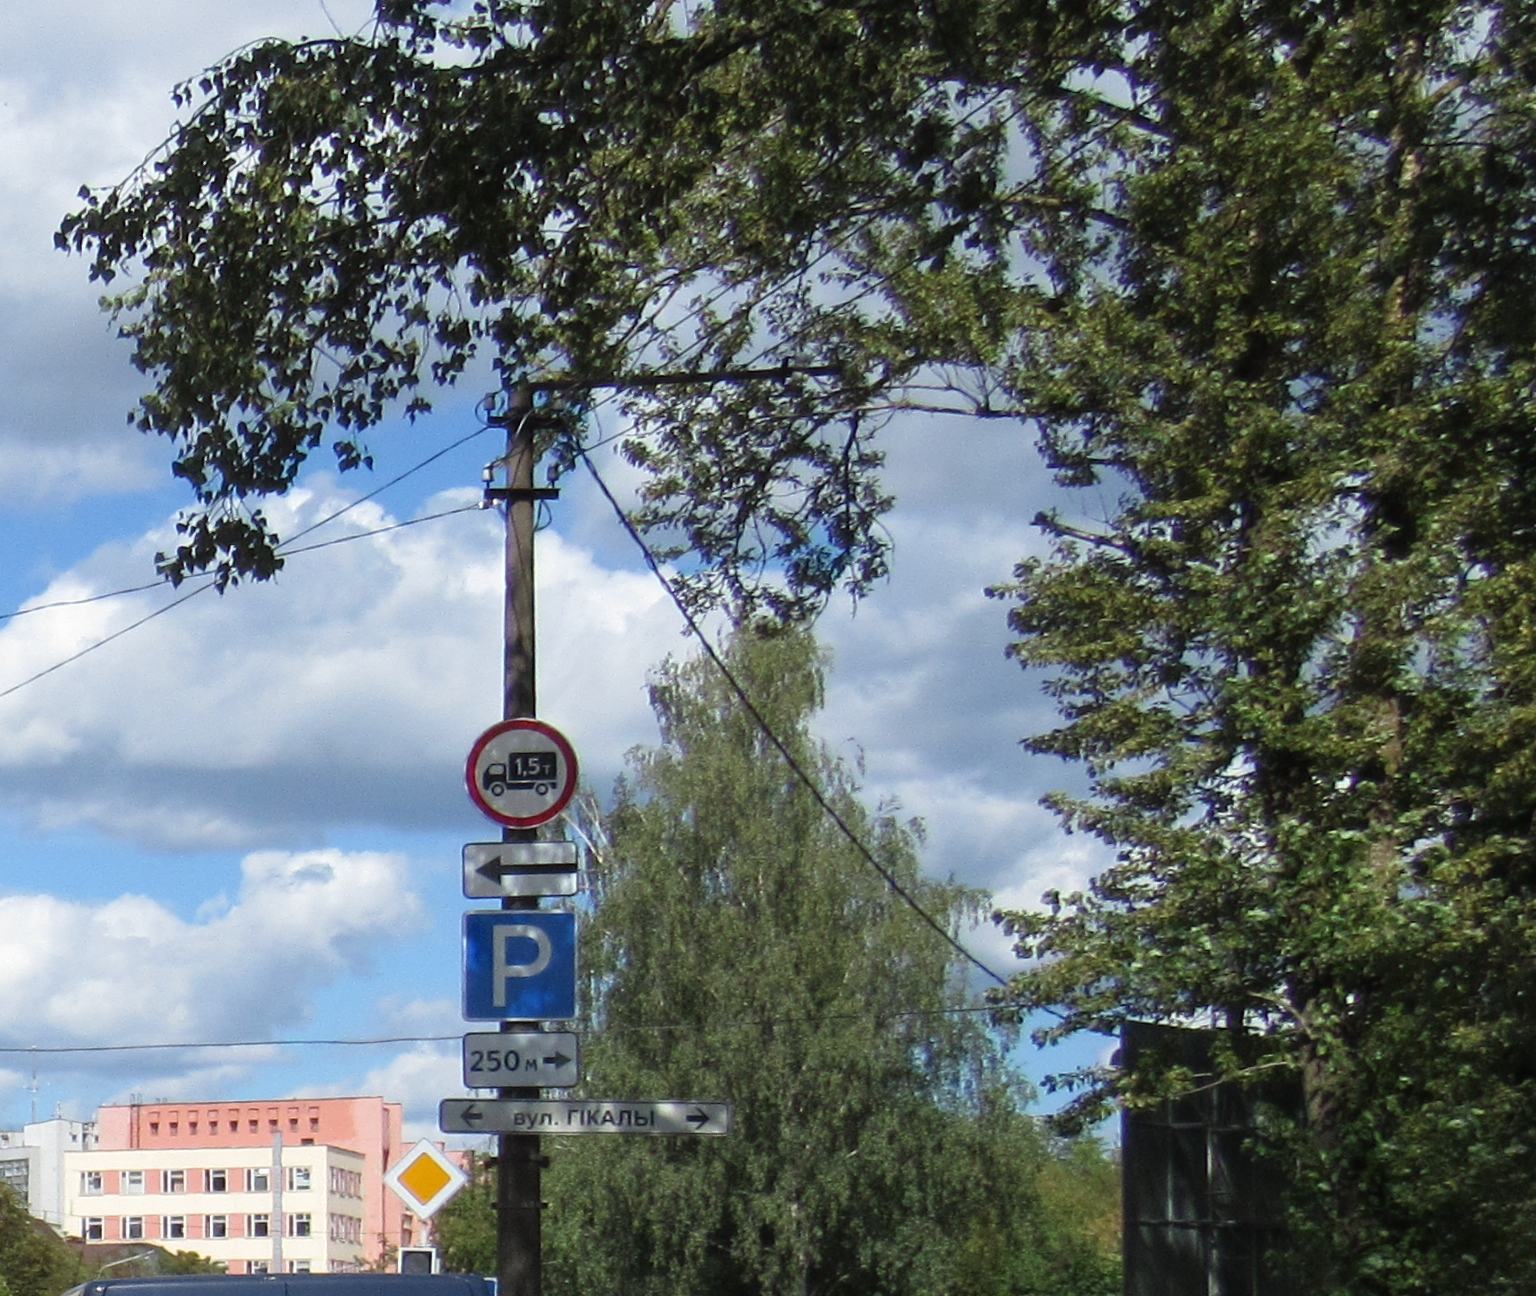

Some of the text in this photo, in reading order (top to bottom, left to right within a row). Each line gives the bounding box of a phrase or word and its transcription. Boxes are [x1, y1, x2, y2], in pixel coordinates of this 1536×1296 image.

[492, 925, 553, 1008] P
[513, 1109, 655, 1130] вул. ГІКАЛЫ
